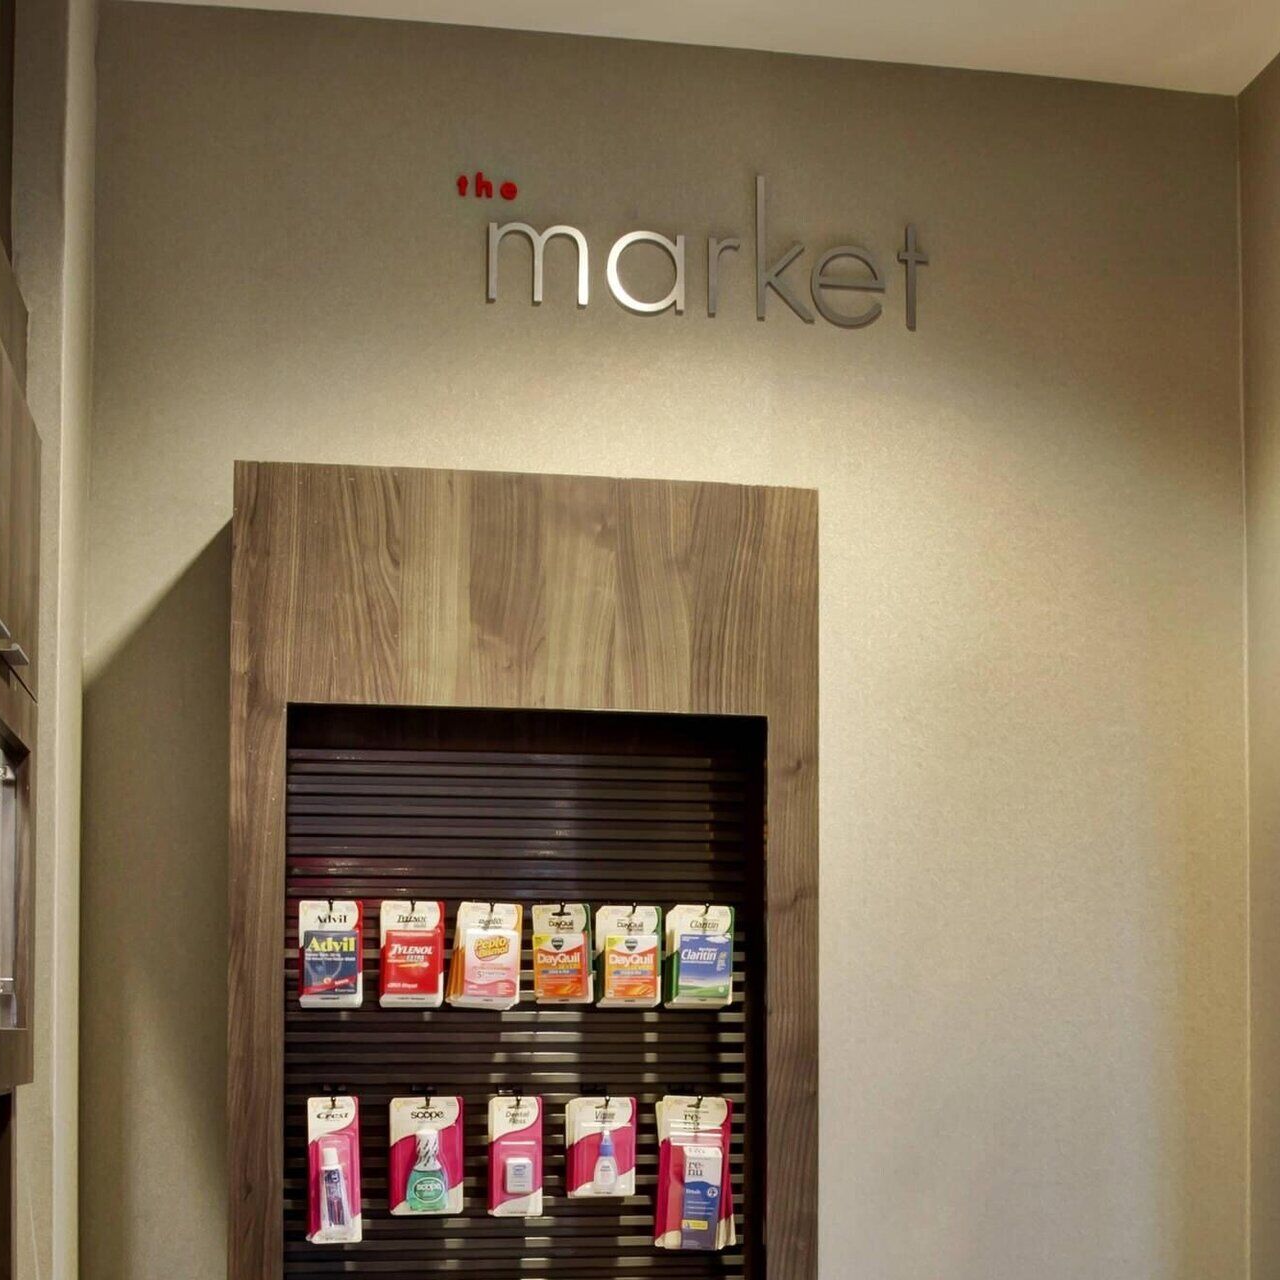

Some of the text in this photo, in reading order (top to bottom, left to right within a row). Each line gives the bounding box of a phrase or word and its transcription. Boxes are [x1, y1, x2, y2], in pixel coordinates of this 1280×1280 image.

[457, 172, 517, 200] the
[486, 175, 929, 332] market
[315, 915, 347, 924] Advil
[689, 919, 719, 930] Claritin
[308, 936, 357, 952] Advil
[390, 943, 434, 957] TYLENOL
[538, 952, 581, 966] DayQuil
[609, 953, 655, 967] DayQuil
[681, 948, 717, 962] Claritin
[410, 1110, 445, 1121] scope
